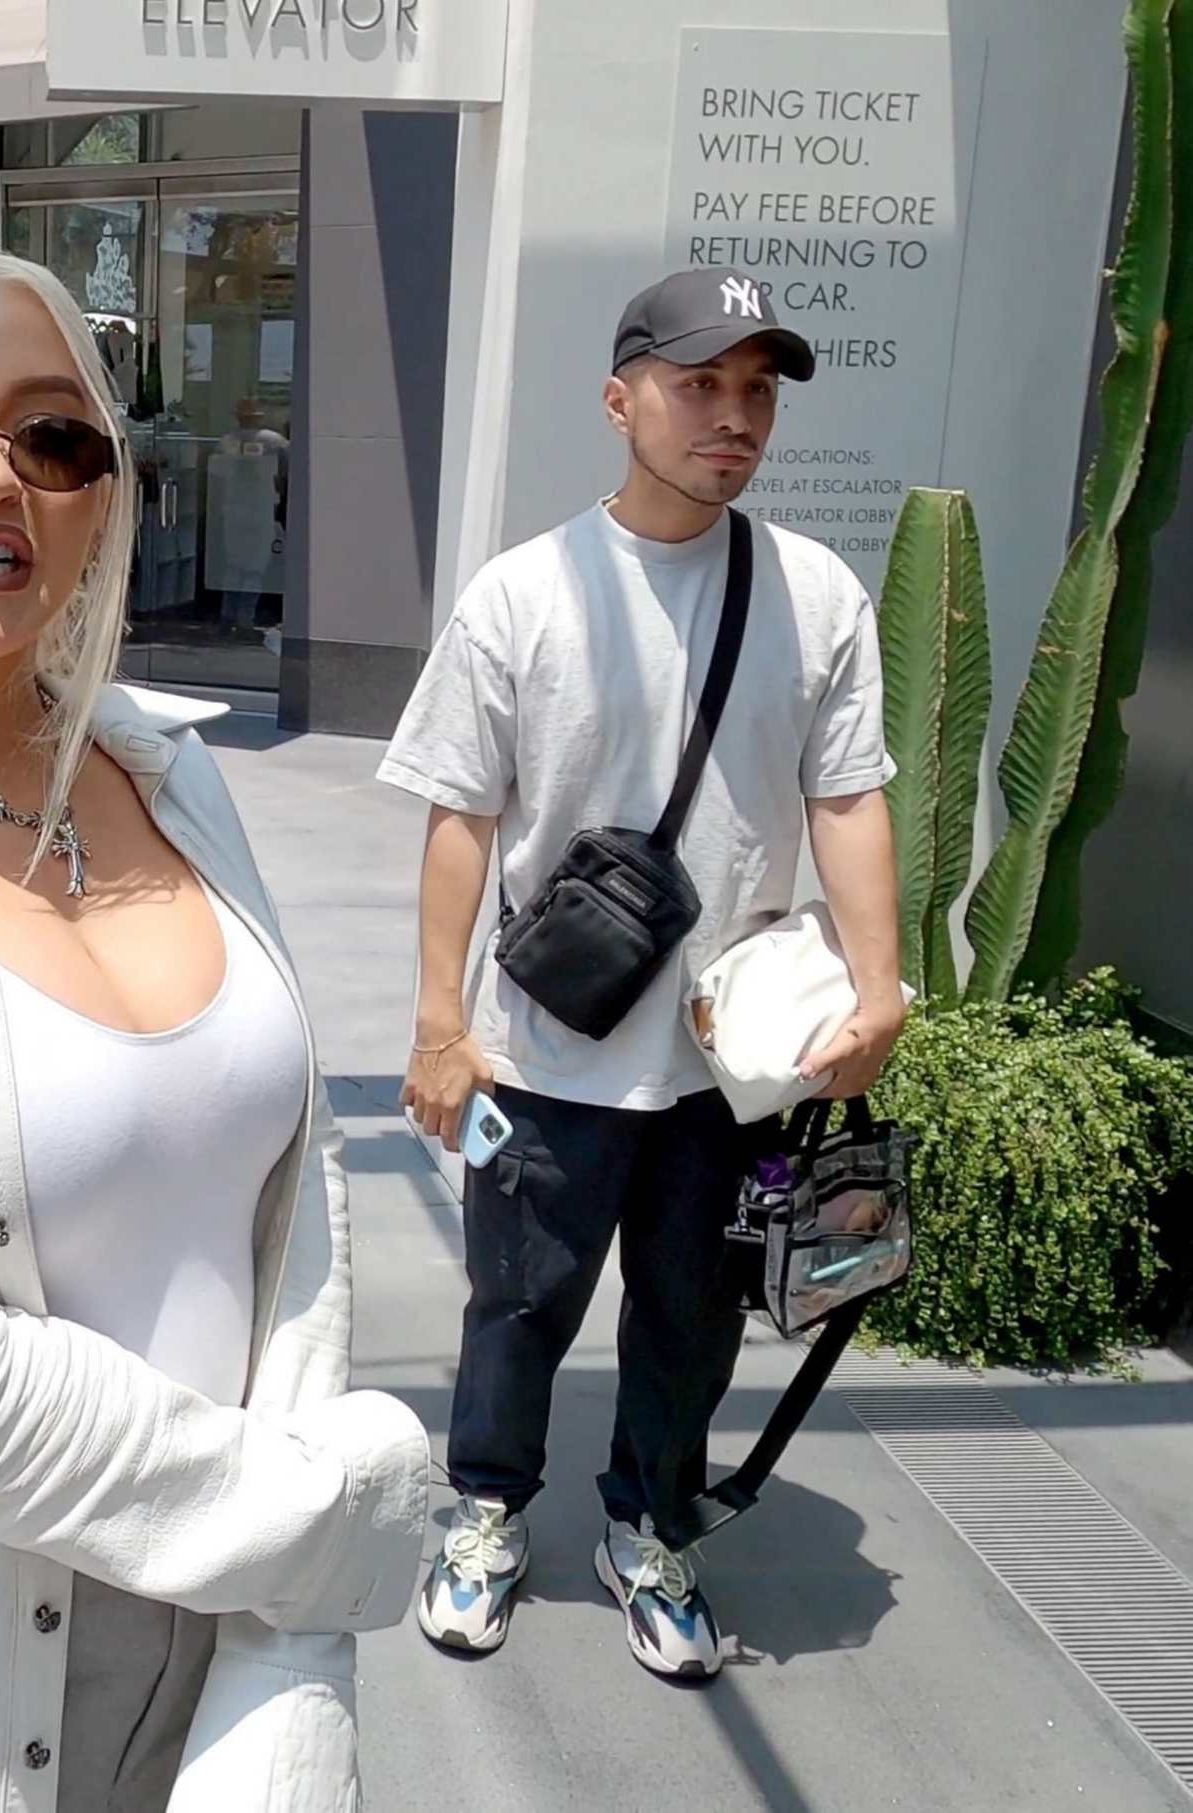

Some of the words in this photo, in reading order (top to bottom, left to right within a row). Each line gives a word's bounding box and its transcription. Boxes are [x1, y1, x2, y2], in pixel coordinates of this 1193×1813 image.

[701, 88, 805, 120] BRING
[815, 91, 921, 122] TICKET
[698, 133, 783, 164] WITH
[794, 136, 870, 167] YOU.
[693, 192, 749, 221] PAY
[758, 193, 809, 222] FEE
[818, 195, 937, 225] BEFORE
[689, 237, 876, 268] RETURNING
[886, 240, 928, 270] TO
[783, 282, 856, 312] CAR.
[806, 338, 898, 368] HIERS
[777, 449, 875, 465] LOCATIONS:
[789, 478, 809, 494] AT
[813, 479, 903, 495] ESCALATOR
[770, 507, 845, 523] ELEVATOR
[848, 508, 897, 524] LOBBY
[841, 537, 890, 552] LOBBY
